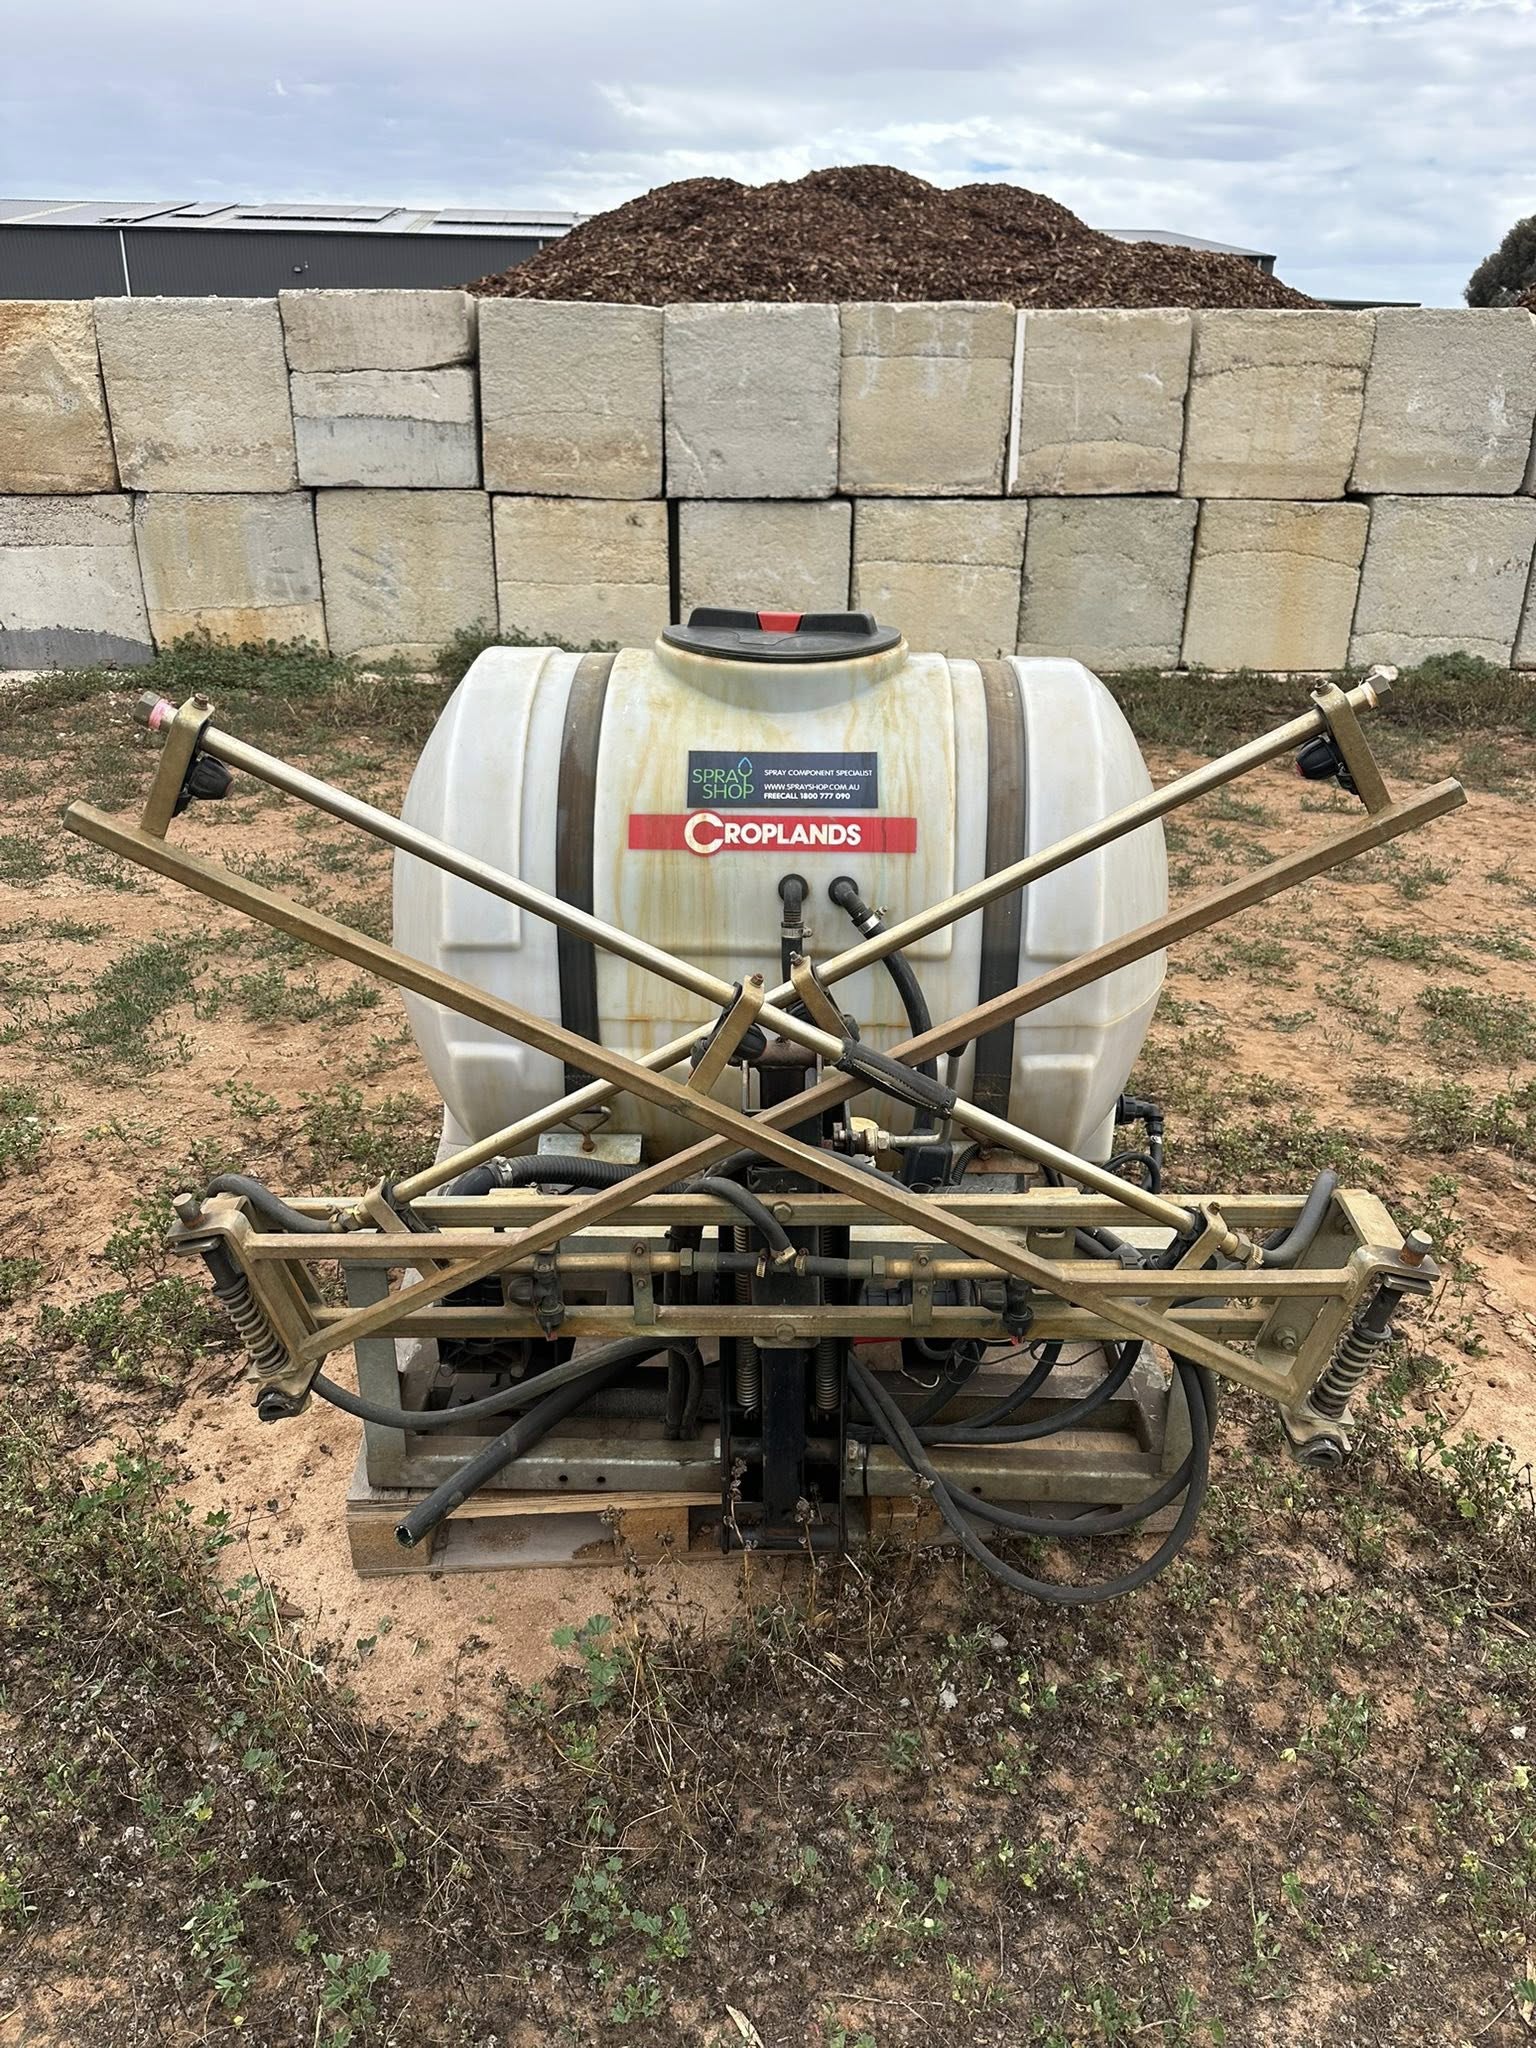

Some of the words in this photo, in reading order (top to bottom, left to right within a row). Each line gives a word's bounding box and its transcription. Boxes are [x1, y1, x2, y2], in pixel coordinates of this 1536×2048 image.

[692, 768, 753, 784] SPRAY
[764, 769, 786, 777] SPRAY
[788, 769, 834, 777] COMPONENT
[836, 769, 873, 777] SPECIALIST
[702, 783, 755, 800] SHOP
[764, 783, 860, 791] WWW.SPRAYSHOP.COM.AU
[764, 792, 798, 800] FREECALL
[800, 792, 817, 800] 1800
[819, 792, 833, 800] 777
[835, 792, 851, 800] 090
[684, 812, 862, 854] CROPLANDS
